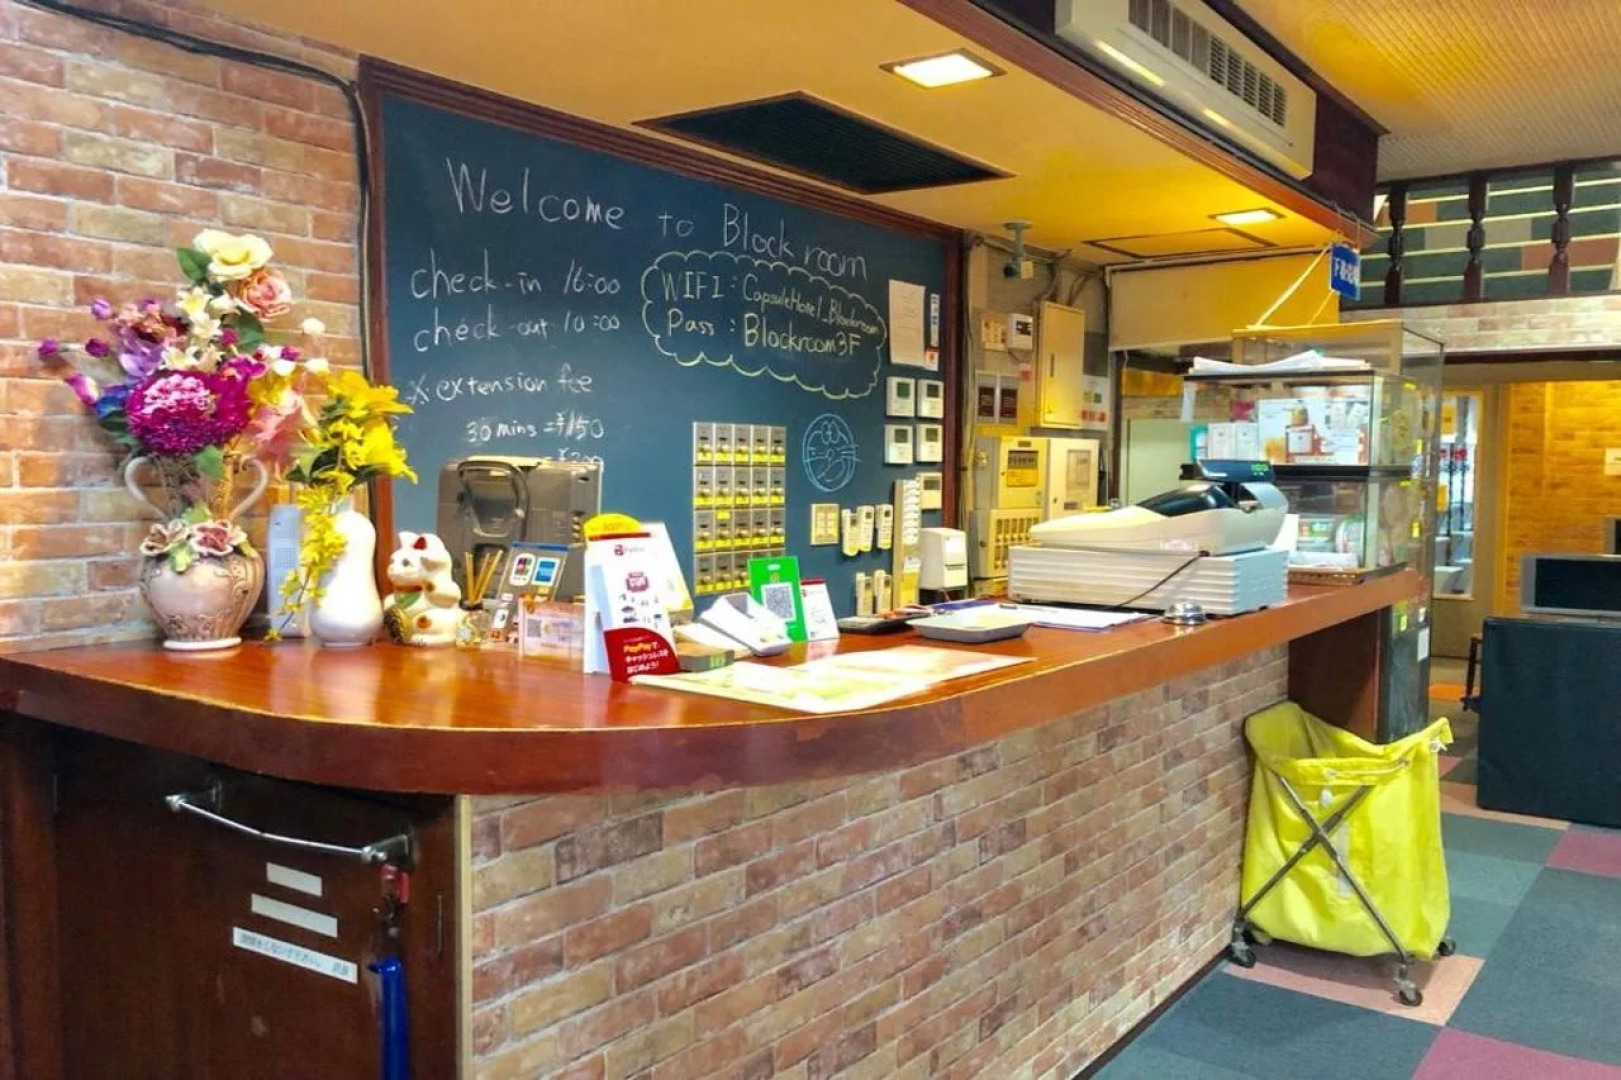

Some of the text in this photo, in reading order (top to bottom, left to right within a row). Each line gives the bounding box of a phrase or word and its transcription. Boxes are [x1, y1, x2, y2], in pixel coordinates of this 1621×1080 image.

[446, 157, 868, 280] Welcome to Block room
[564, 258, 620, 294] 16:00
[564, 308, 620, 334] 10:00
[743, 313, 862, 356] Blockroom3F
[436, 372, 547, 401] extension
[558, 362, 593, 394] fee
